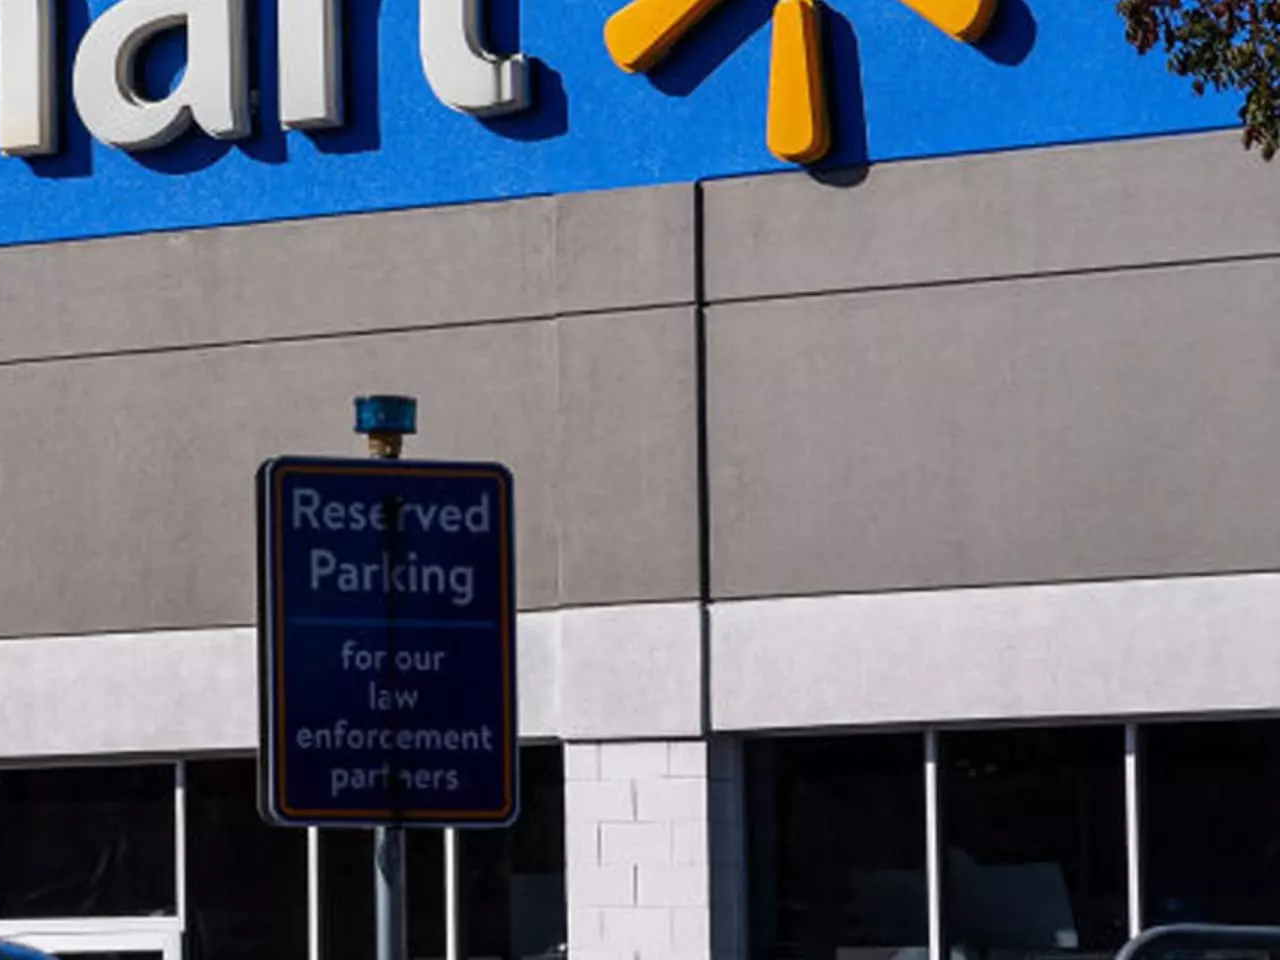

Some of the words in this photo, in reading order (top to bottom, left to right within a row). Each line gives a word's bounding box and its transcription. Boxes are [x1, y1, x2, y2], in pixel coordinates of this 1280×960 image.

[291, 487, 491, 533] Reserved
[309, 548, 474, 606] Parking
[341, 640, 387, 671] for
[394, 649, 445, 672] our
[370, 681, 418, 710] law
[295, 719, 493, 752] enforcement
